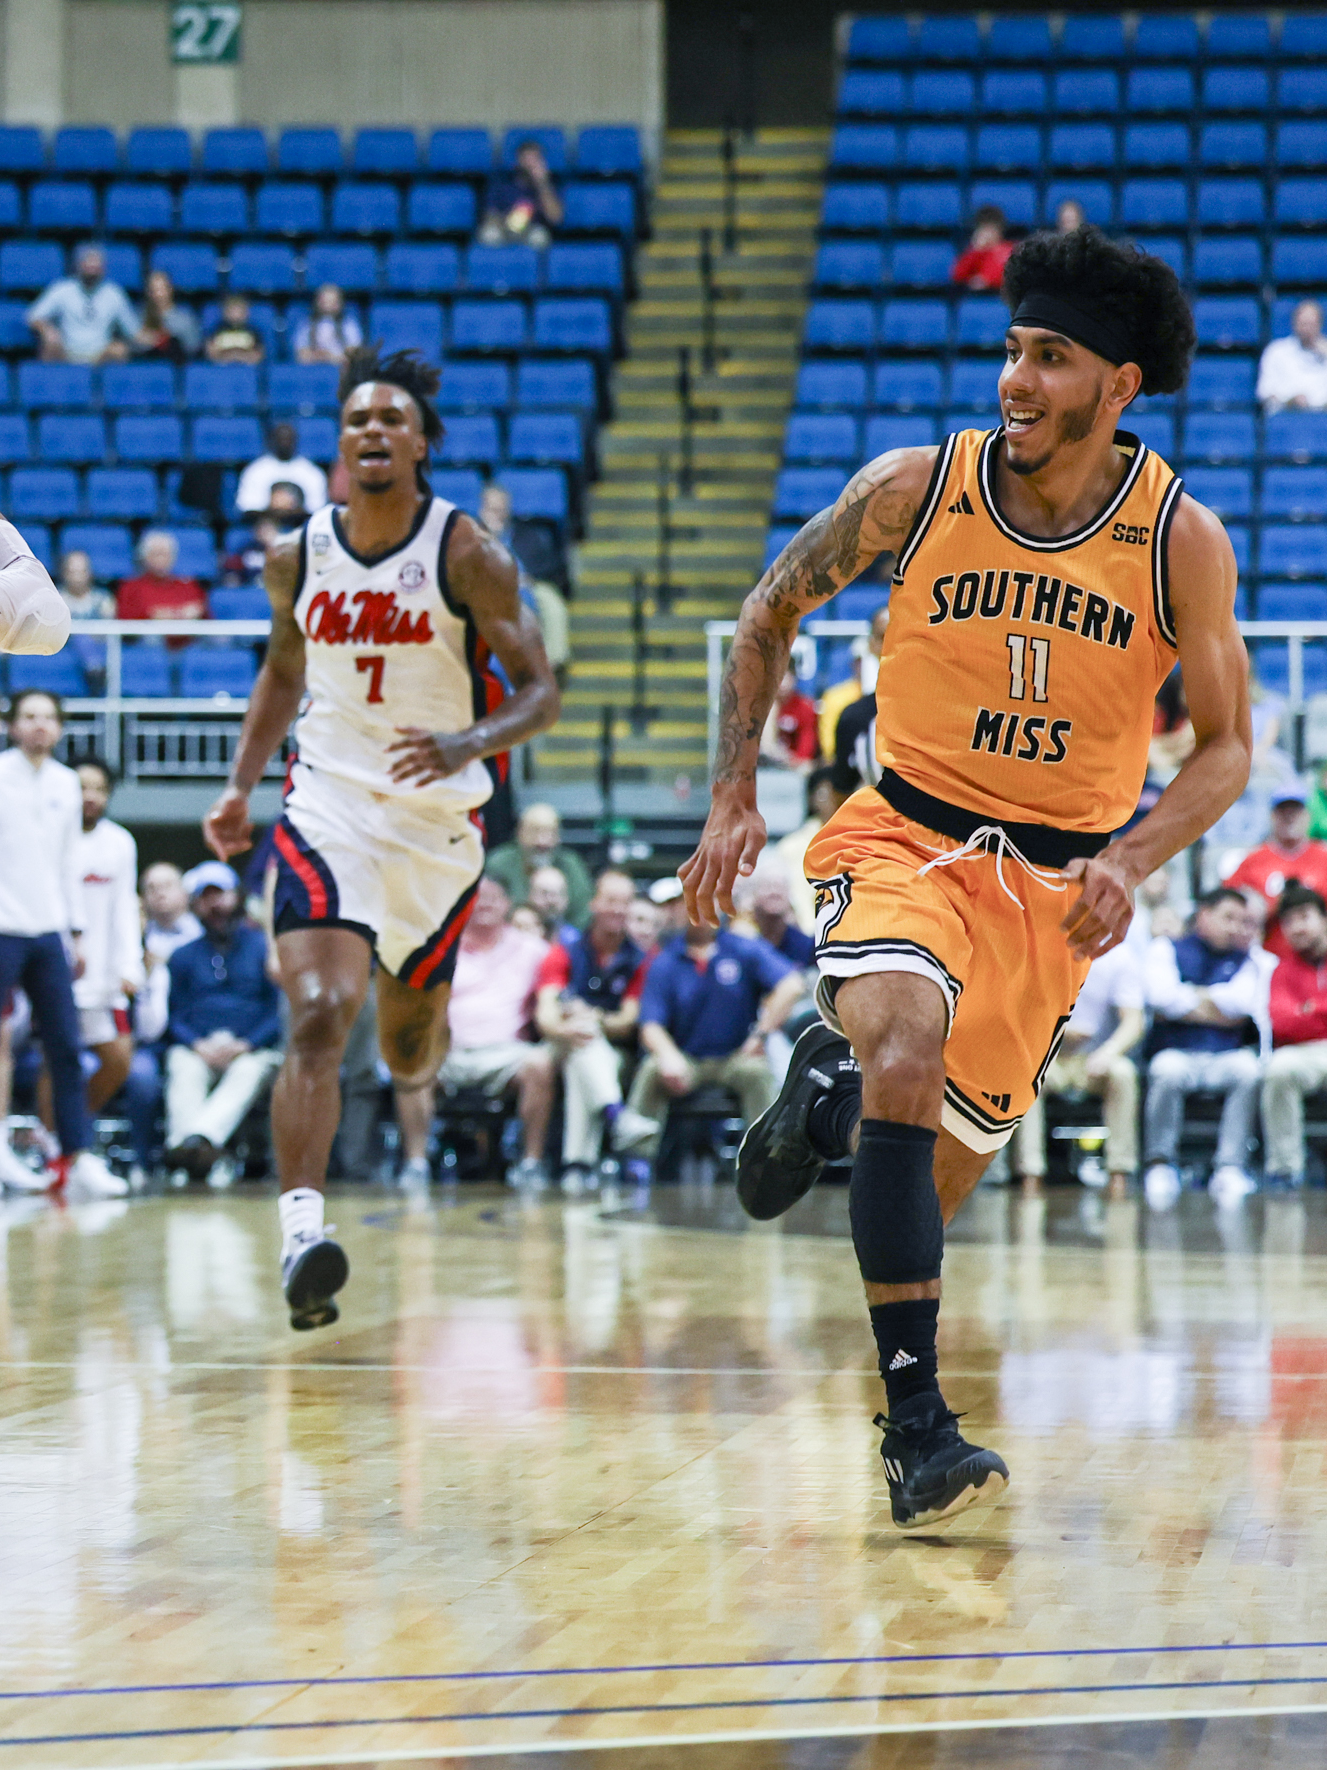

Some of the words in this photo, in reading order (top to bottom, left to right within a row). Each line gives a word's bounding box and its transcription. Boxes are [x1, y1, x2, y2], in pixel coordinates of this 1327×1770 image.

[173, 5, 241, 58] 27
[1112, 522, 1150, 545] SBC
[306, 590, 352, 646] Ole
[351, 590, 434, 646] Miss
[927, 569, 1136, 651] SOUTHERN
[355, 655, 385, 704] 7
[1006, 633, 1050, 703] 11
[970, 706, 1073, 764] MISS
[889, 1356, 918, 1371] adidas
